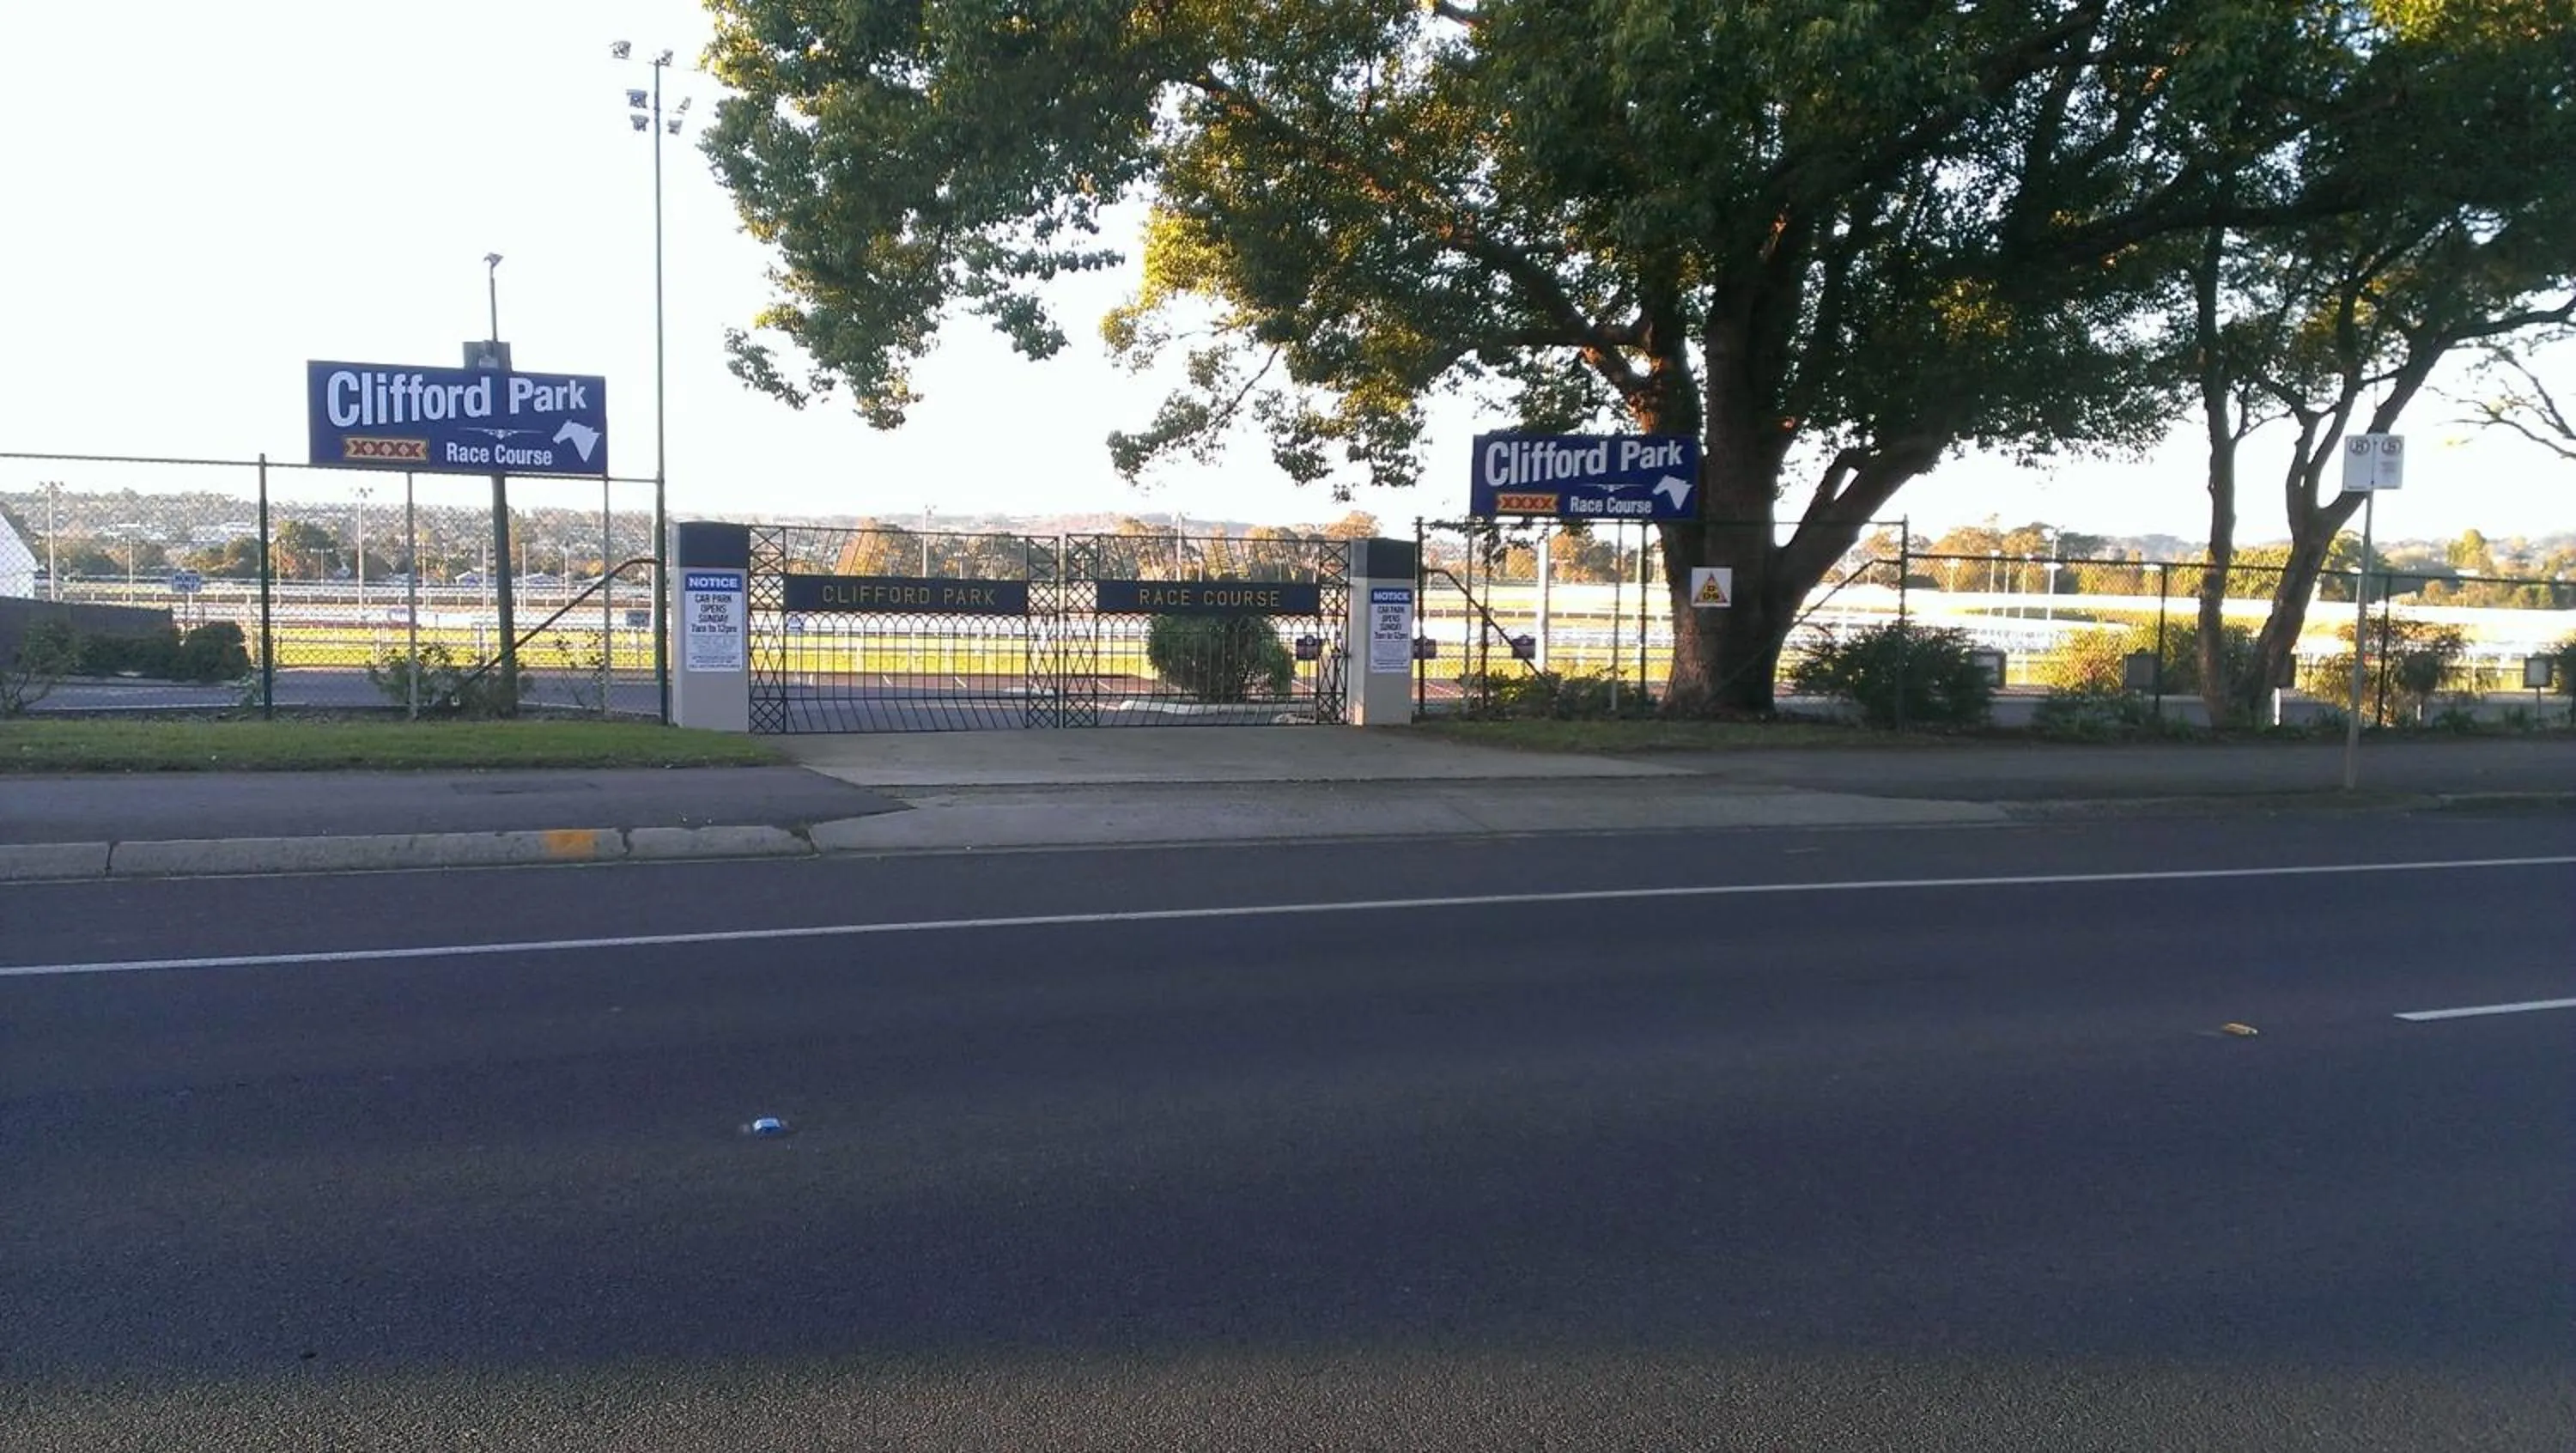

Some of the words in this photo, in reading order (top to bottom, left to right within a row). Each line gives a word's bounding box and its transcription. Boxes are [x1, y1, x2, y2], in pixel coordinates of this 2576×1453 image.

[327, 370, 491, 428] Clifford
[508, 377, 587, 415] Park
[349, 439, 422, 458] XXXX
[446, 442, 489, 465] Race
[495, 444, 553, 465] Course
[1485, 441, 1608, 487] Clifford
[1621, 440, 1683, 471] Park
[1502, 495, 1556, 509] XXXX
[1570, 495, 1603, 513] Race
[1607, 497, 1653, 514] Course
[689, 577, 738, 588] NOTICE
[695, 594, 709, 603] CAR
[712, 594, 732, 603] PARK
[822, 585, 931, 605] CLIFFORD
[944, 587, 995, 605] PARK
[1139, 588, 1191, 605] RACE
[1204, 590, 1280, 607] COURSE
[1374, 591, 1410, 601] NOTICE
[700, 605, 726, 613] OPENS
[698, 614, 728, 623] SUNDAY
[1380, 623, 1402, 631] SUNDAY
